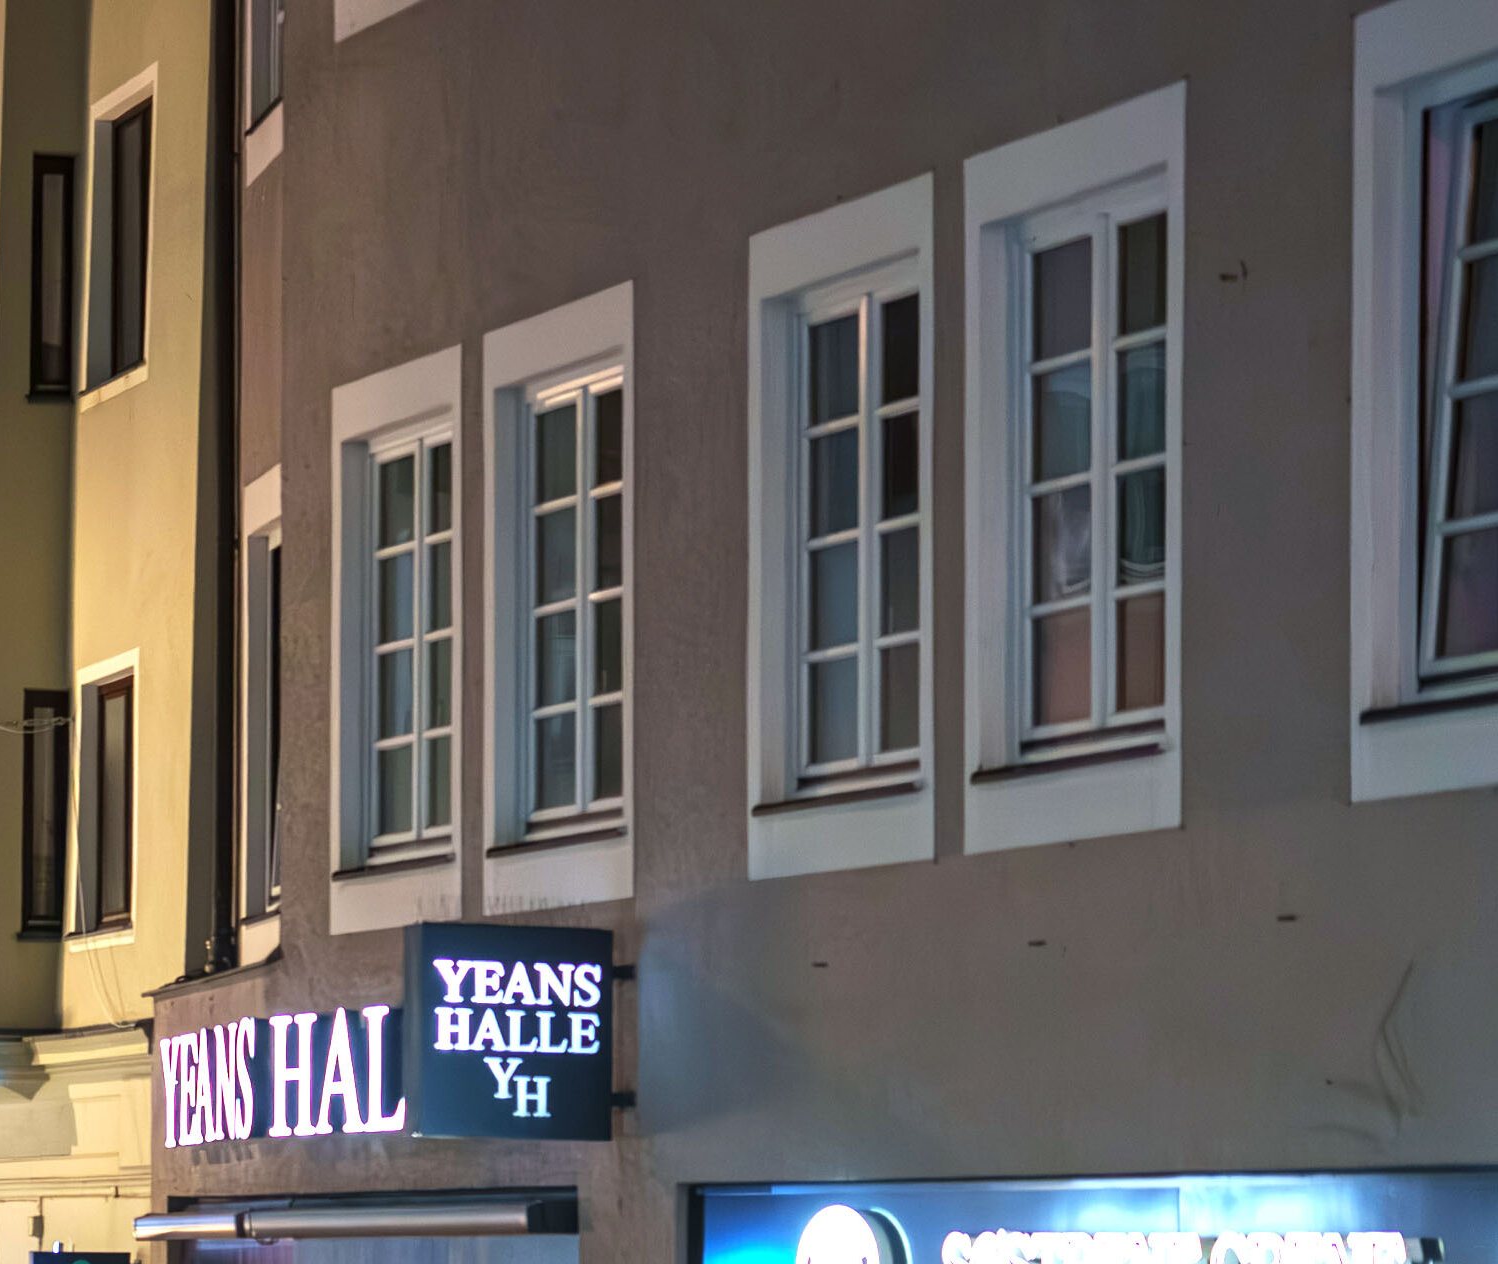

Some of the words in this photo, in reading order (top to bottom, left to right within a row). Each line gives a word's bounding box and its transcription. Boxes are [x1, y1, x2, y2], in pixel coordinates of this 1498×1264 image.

[431, 958, 603, 1007] YEANS
[433, 1006, 601, 1054] HALLE
[160, 1017, 256, 1148] YEANS
[269, 1005, 406, 1138] HAL
[483, 1056, 552, 1118] YH
